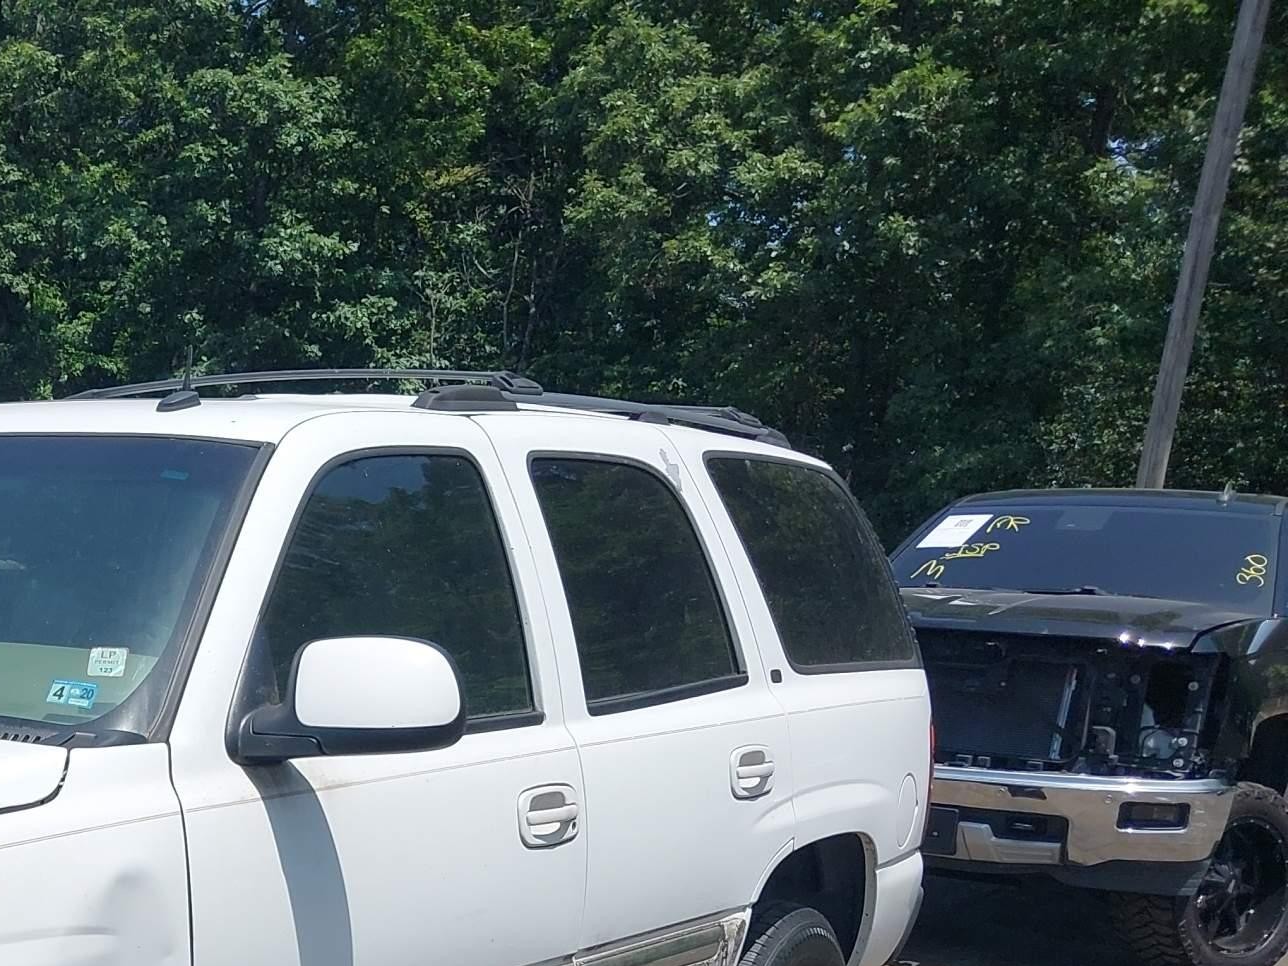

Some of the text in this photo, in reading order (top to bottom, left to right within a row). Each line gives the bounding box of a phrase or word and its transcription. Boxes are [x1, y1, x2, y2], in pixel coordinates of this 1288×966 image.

[1235, 554, 1268, 588] 360
[100, 650, 117, 659] LP
[52, 685, 94, 701] 4 20
